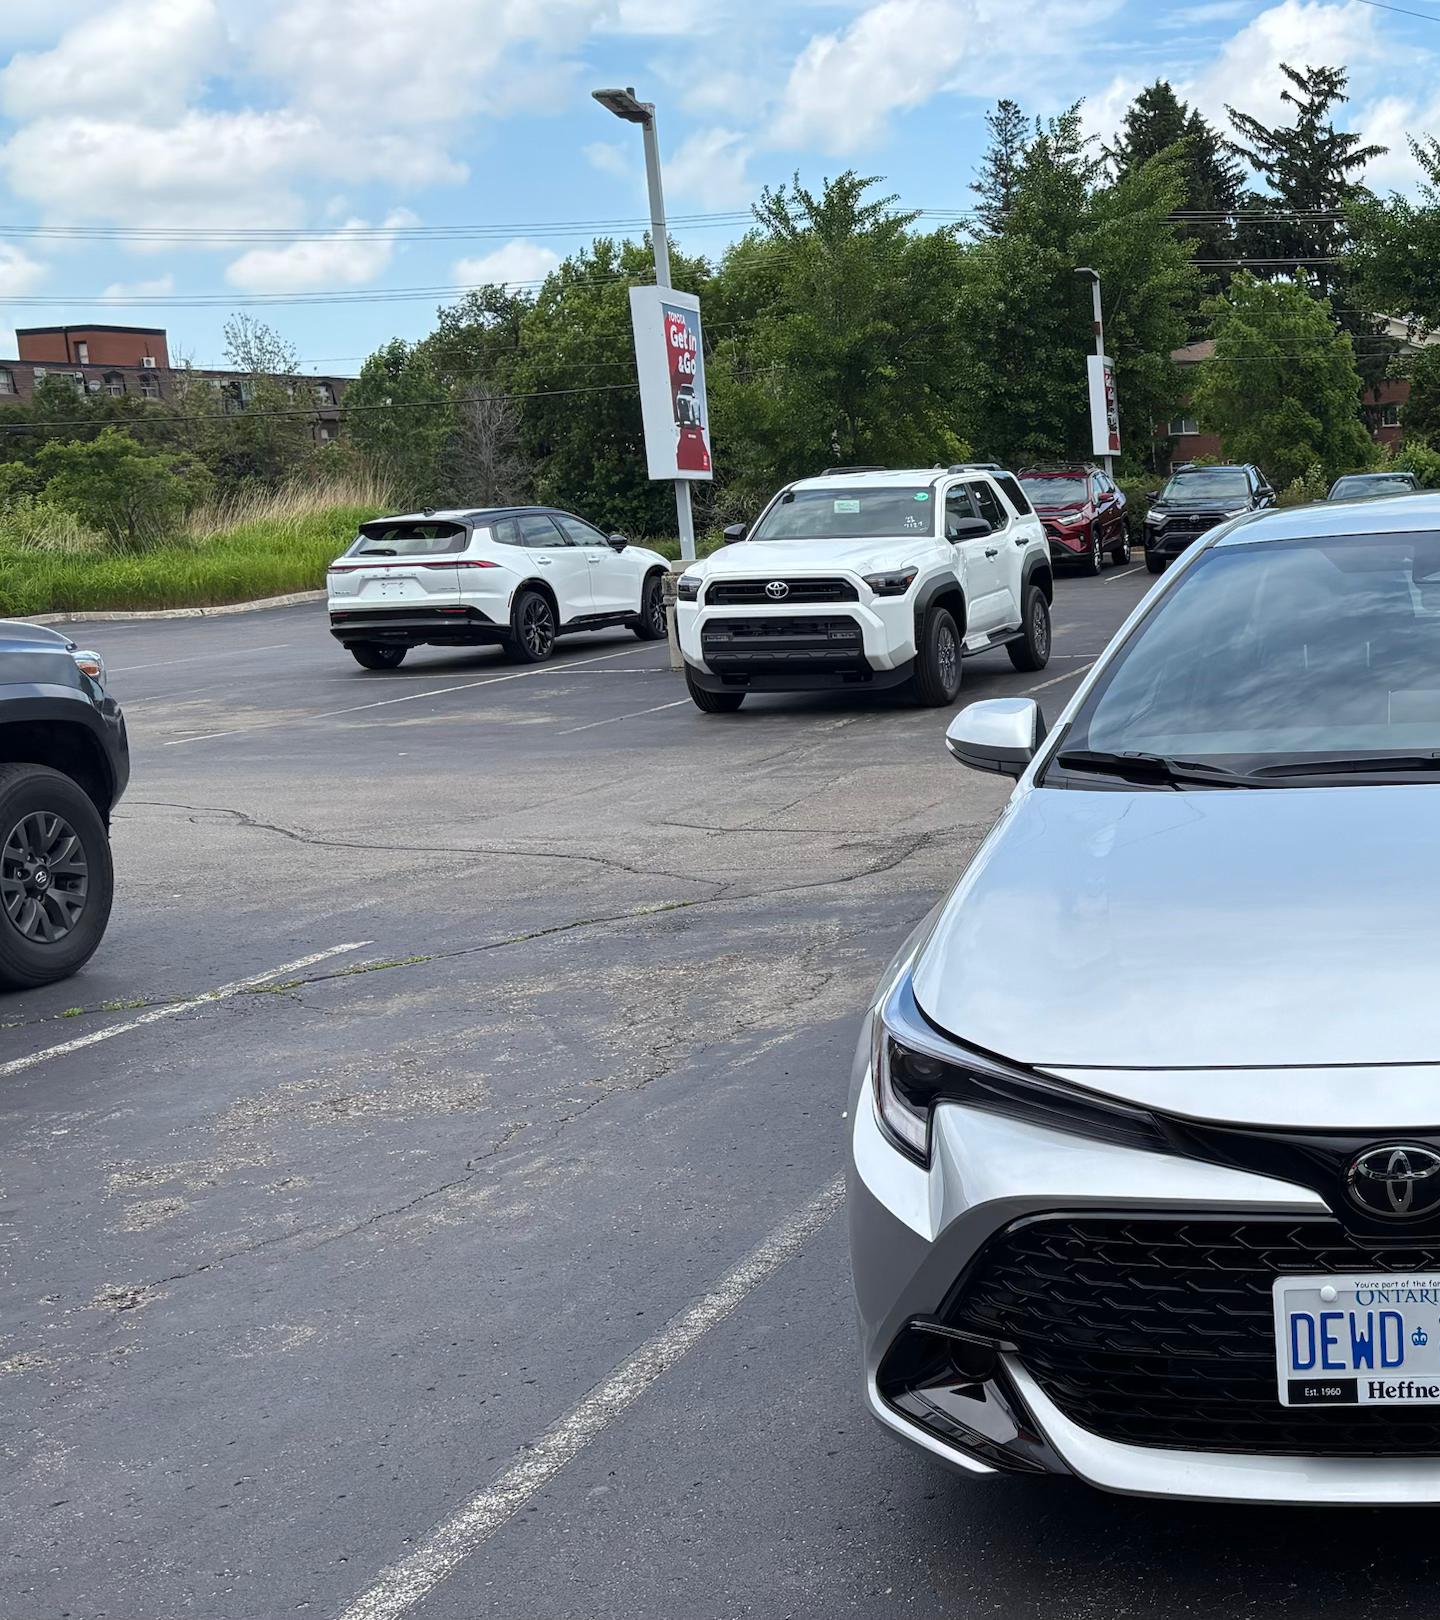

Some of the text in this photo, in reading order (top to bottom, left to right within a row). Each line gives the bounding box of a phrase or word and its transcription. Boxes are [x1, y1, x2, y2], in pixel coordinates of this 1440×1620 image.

[670, 325, 697, 351] Get in
[678, 351, 697, 375] &Go
[1381, 1281, 1399, 1289] part
[1290, 1311, 1405, 1370] DEWD
[1304, 1387, 1342, 1396] Est. 1960
